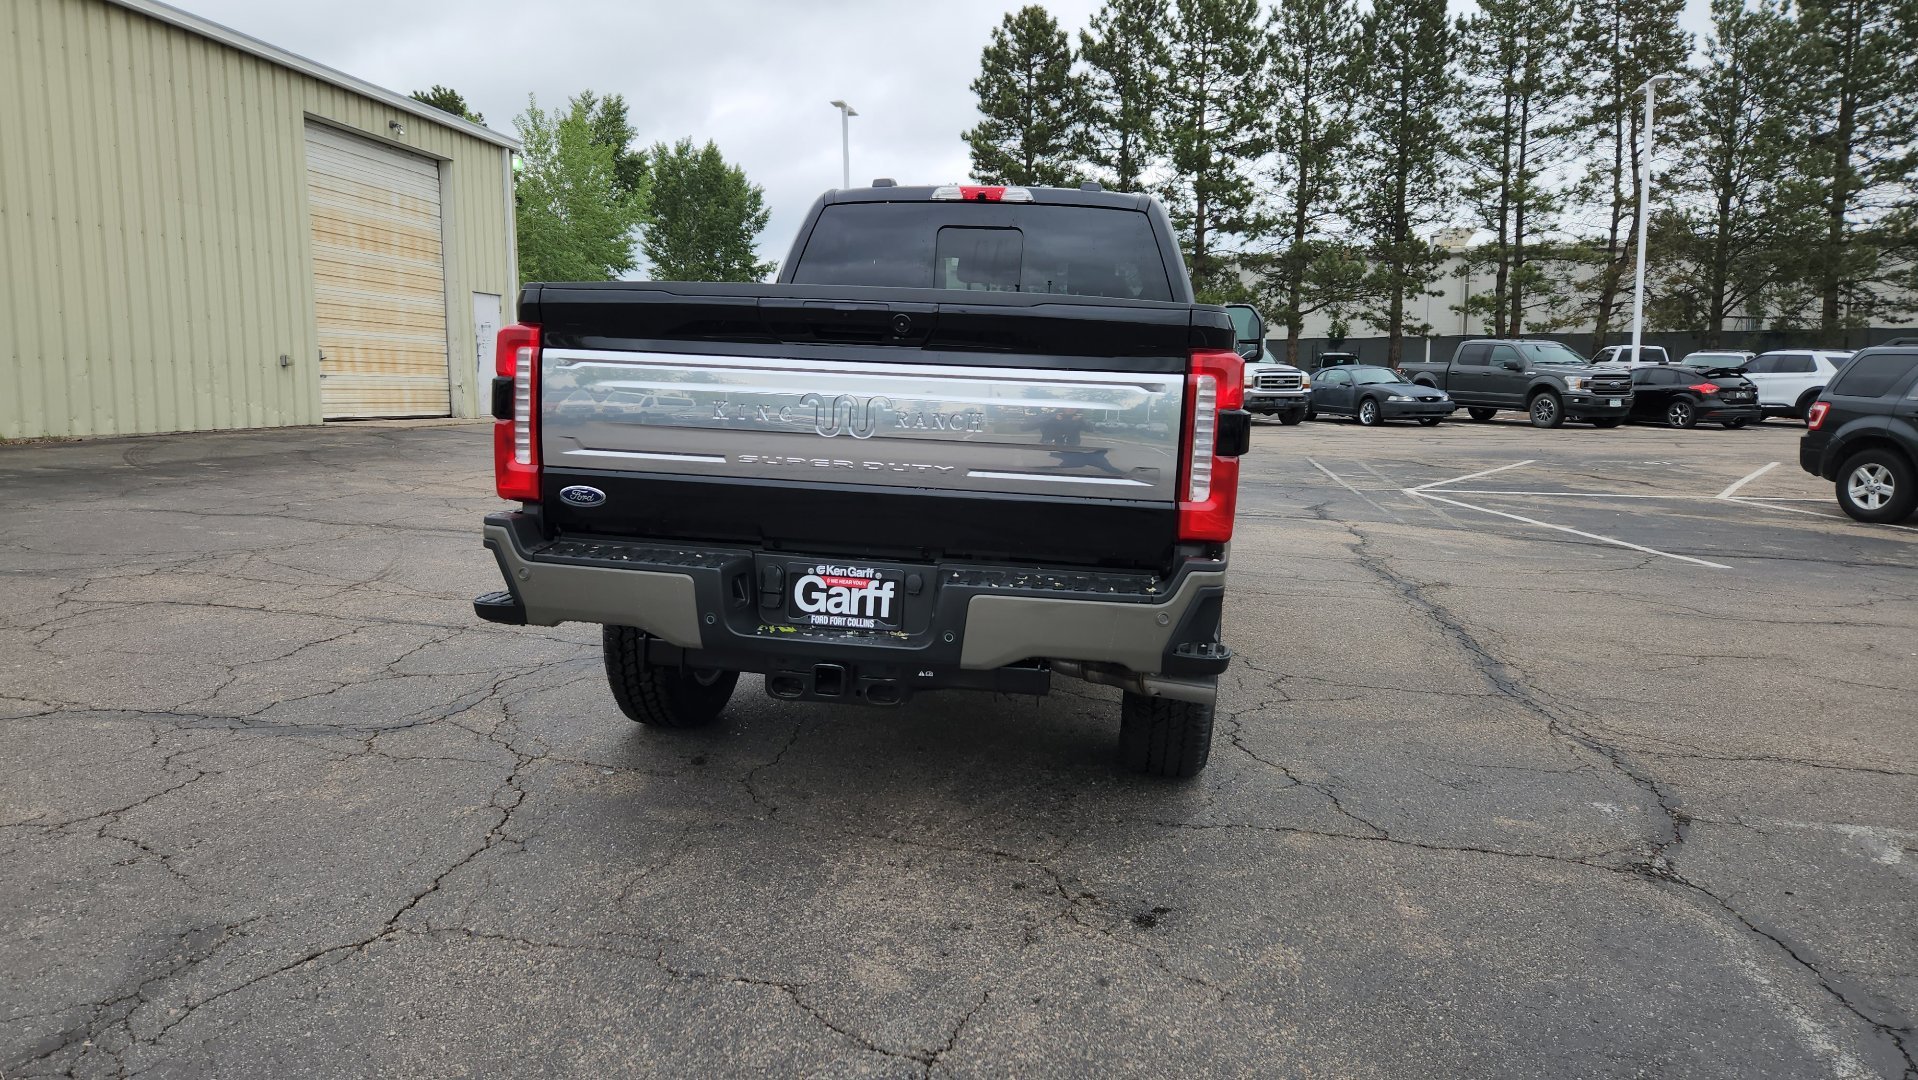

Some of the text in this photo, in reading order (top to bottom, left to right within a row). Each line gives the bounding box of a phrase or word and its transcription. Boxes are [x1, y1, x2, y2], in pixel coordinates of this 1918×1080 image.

[712, 400, 984, 433] KING RANCH
[738, 454, 954, 474] SUPER DUTY
[569, 489, 595, 502] Ford
[826, 565, 875, 578] Ken Garff
[794, 574, 895, 618] Garff
[810, 615, 875, 628] FORD FORT COLLINS
